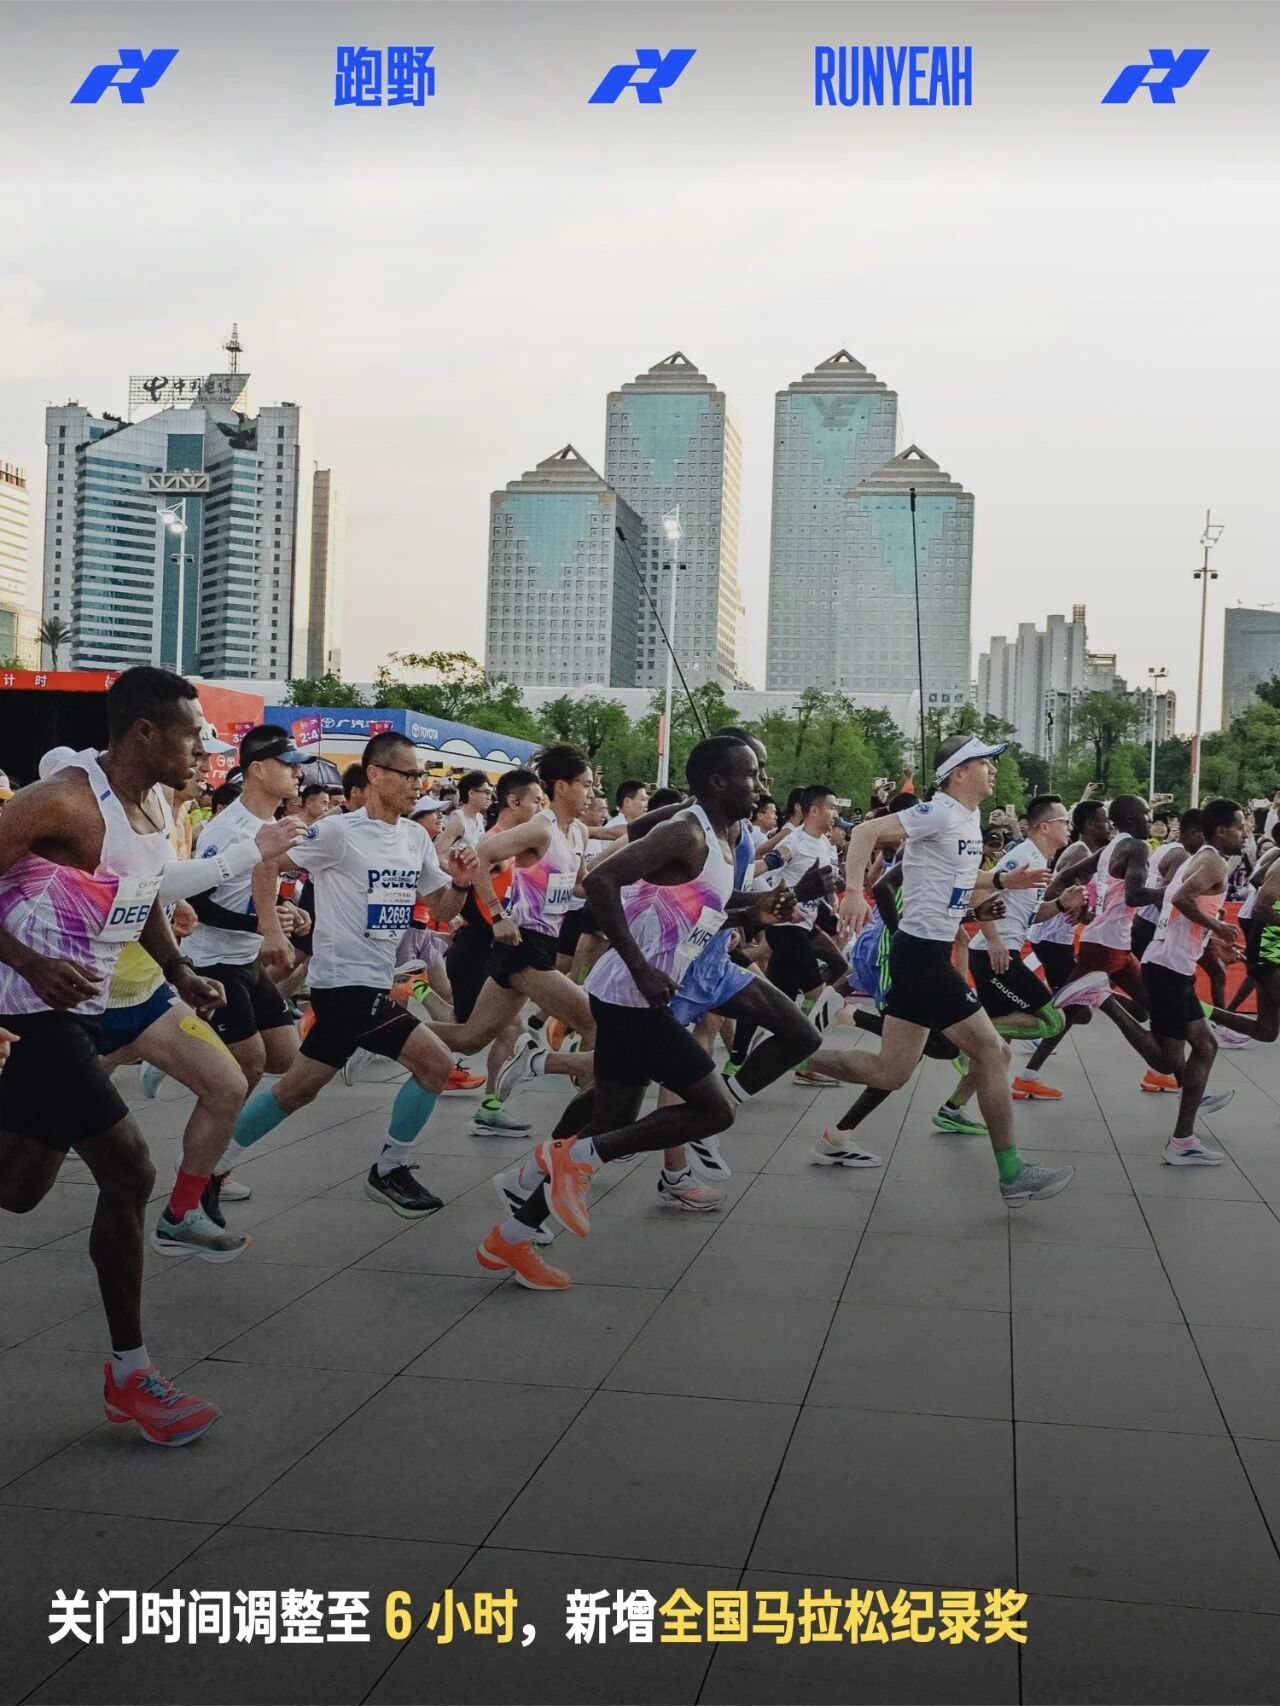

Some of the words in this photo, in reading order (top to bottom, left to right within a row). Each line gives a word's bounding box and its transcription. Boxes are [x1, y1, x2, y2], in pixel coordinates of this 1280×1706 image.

[419, 727, 439, 741] TOYOTA
[379, 906, 411, 924] A2693
[990, 977, 1030, 1009] saucony
